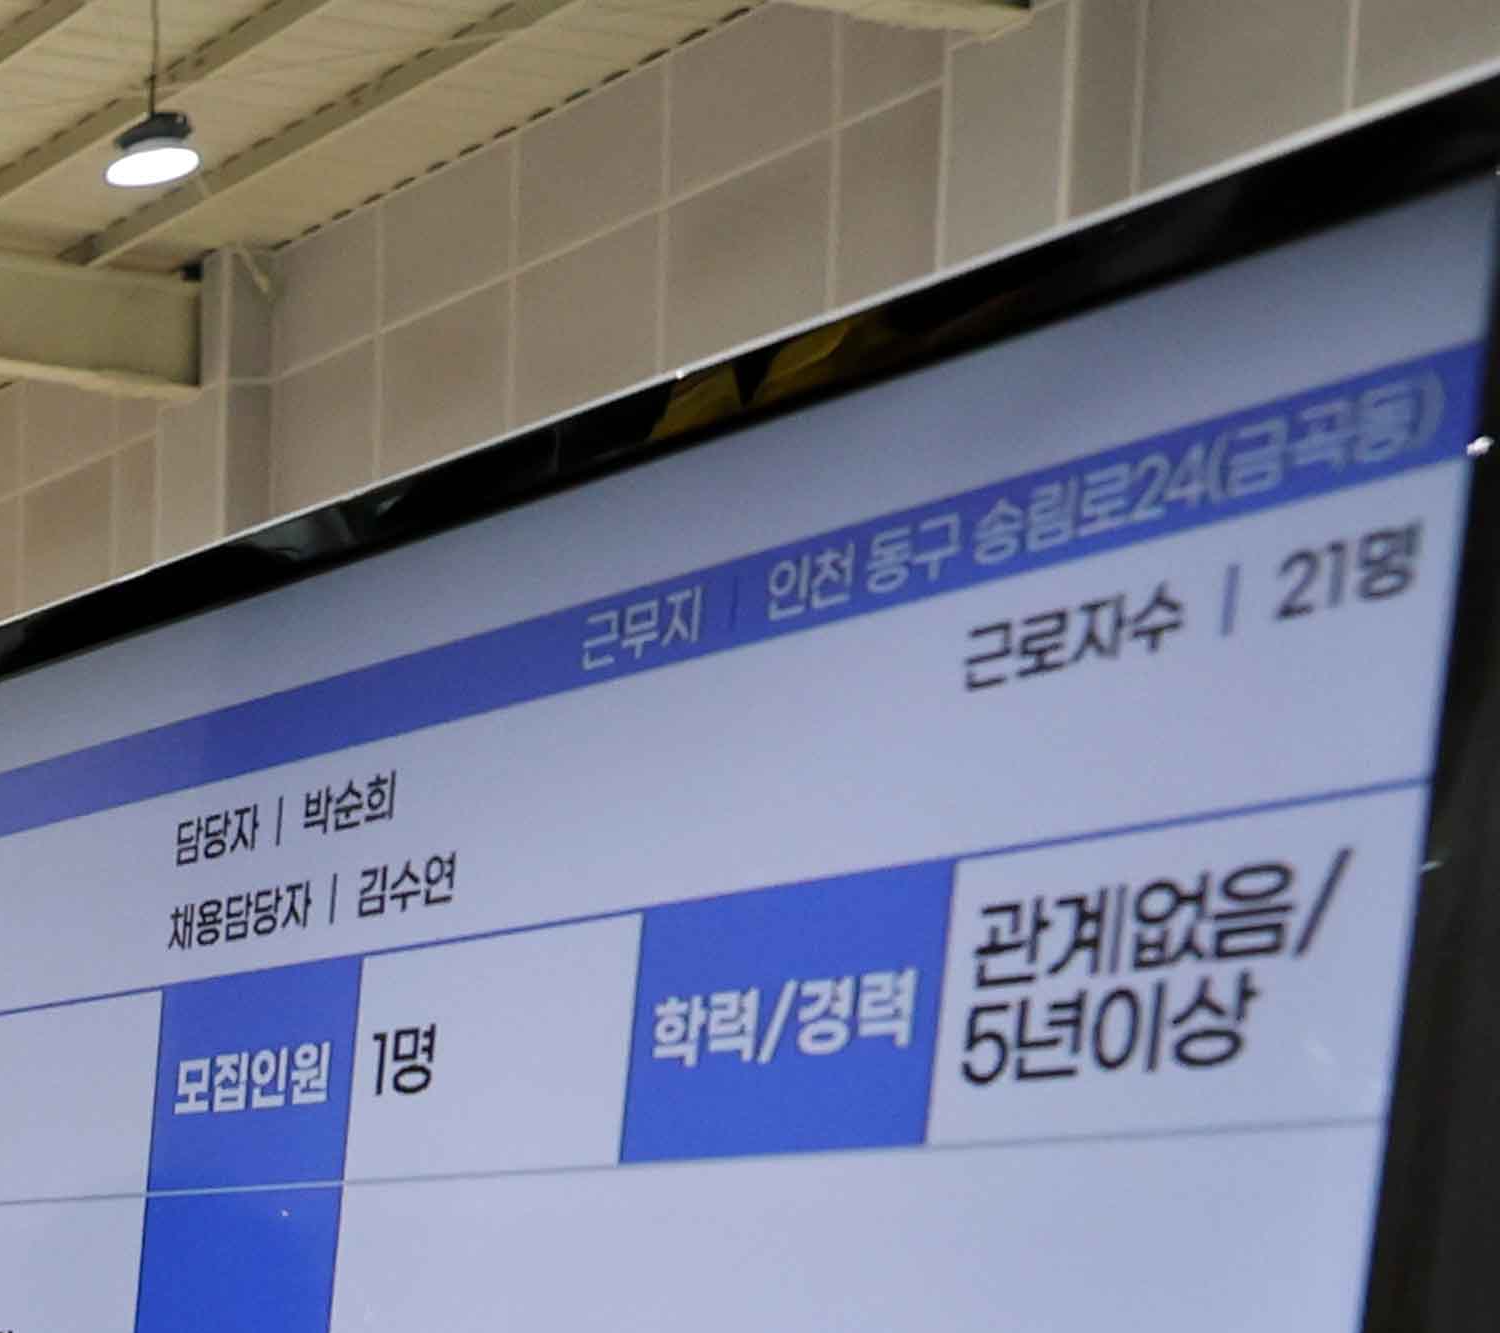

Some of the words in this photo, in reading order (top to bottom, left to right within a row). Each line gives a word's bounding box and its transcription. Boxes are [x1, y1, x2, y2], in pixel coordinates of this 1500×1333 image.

[581, 586, 703, 671] 근무지
[767, 540, 855, 622] 인천
[866, 513, 962, 596] 동구
[965, 580, 1184, 691] 근로자수
[1274, 518, 1424, 621] 21명
[176, 804, 260, 867] 담당자
[303, 770, 397, 835] 박순희
[168, 880, 313, 951] 채용담당자
[357, 852, 458, 918] 김수연
[973, 846, 1354, 988] 관계없음/
[174, 1040, 331, 1116] 모집인원
[372, 1023, 437, 1096] 1명
[651, 967, 918, 1067] 학력/경력
[961, 971, 1259, 1087] 5년이상
